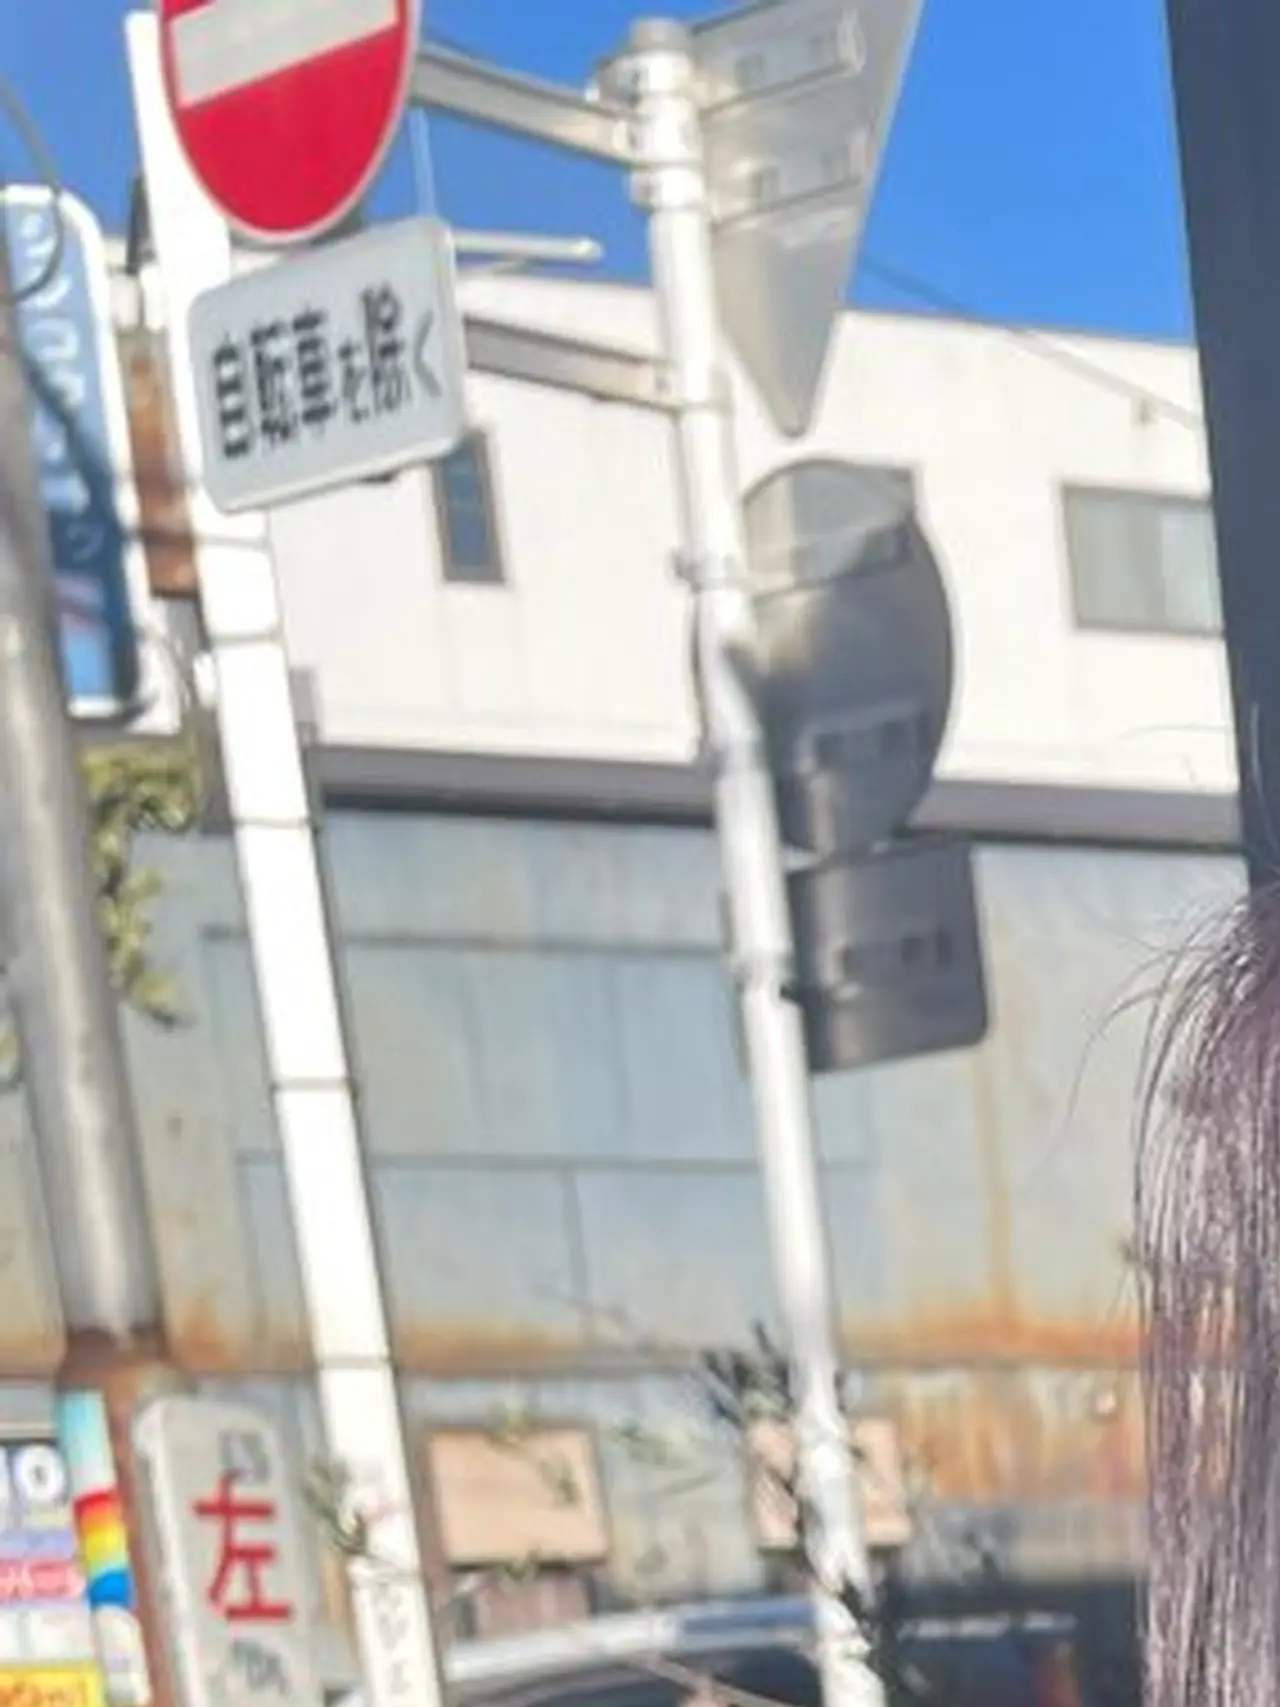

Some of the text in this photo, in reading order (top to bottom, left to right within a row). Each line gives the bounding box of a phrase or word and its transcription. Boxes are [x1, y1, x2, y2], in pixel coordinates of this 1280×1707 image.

[212, 281, 443, 459] 自転車を除く
